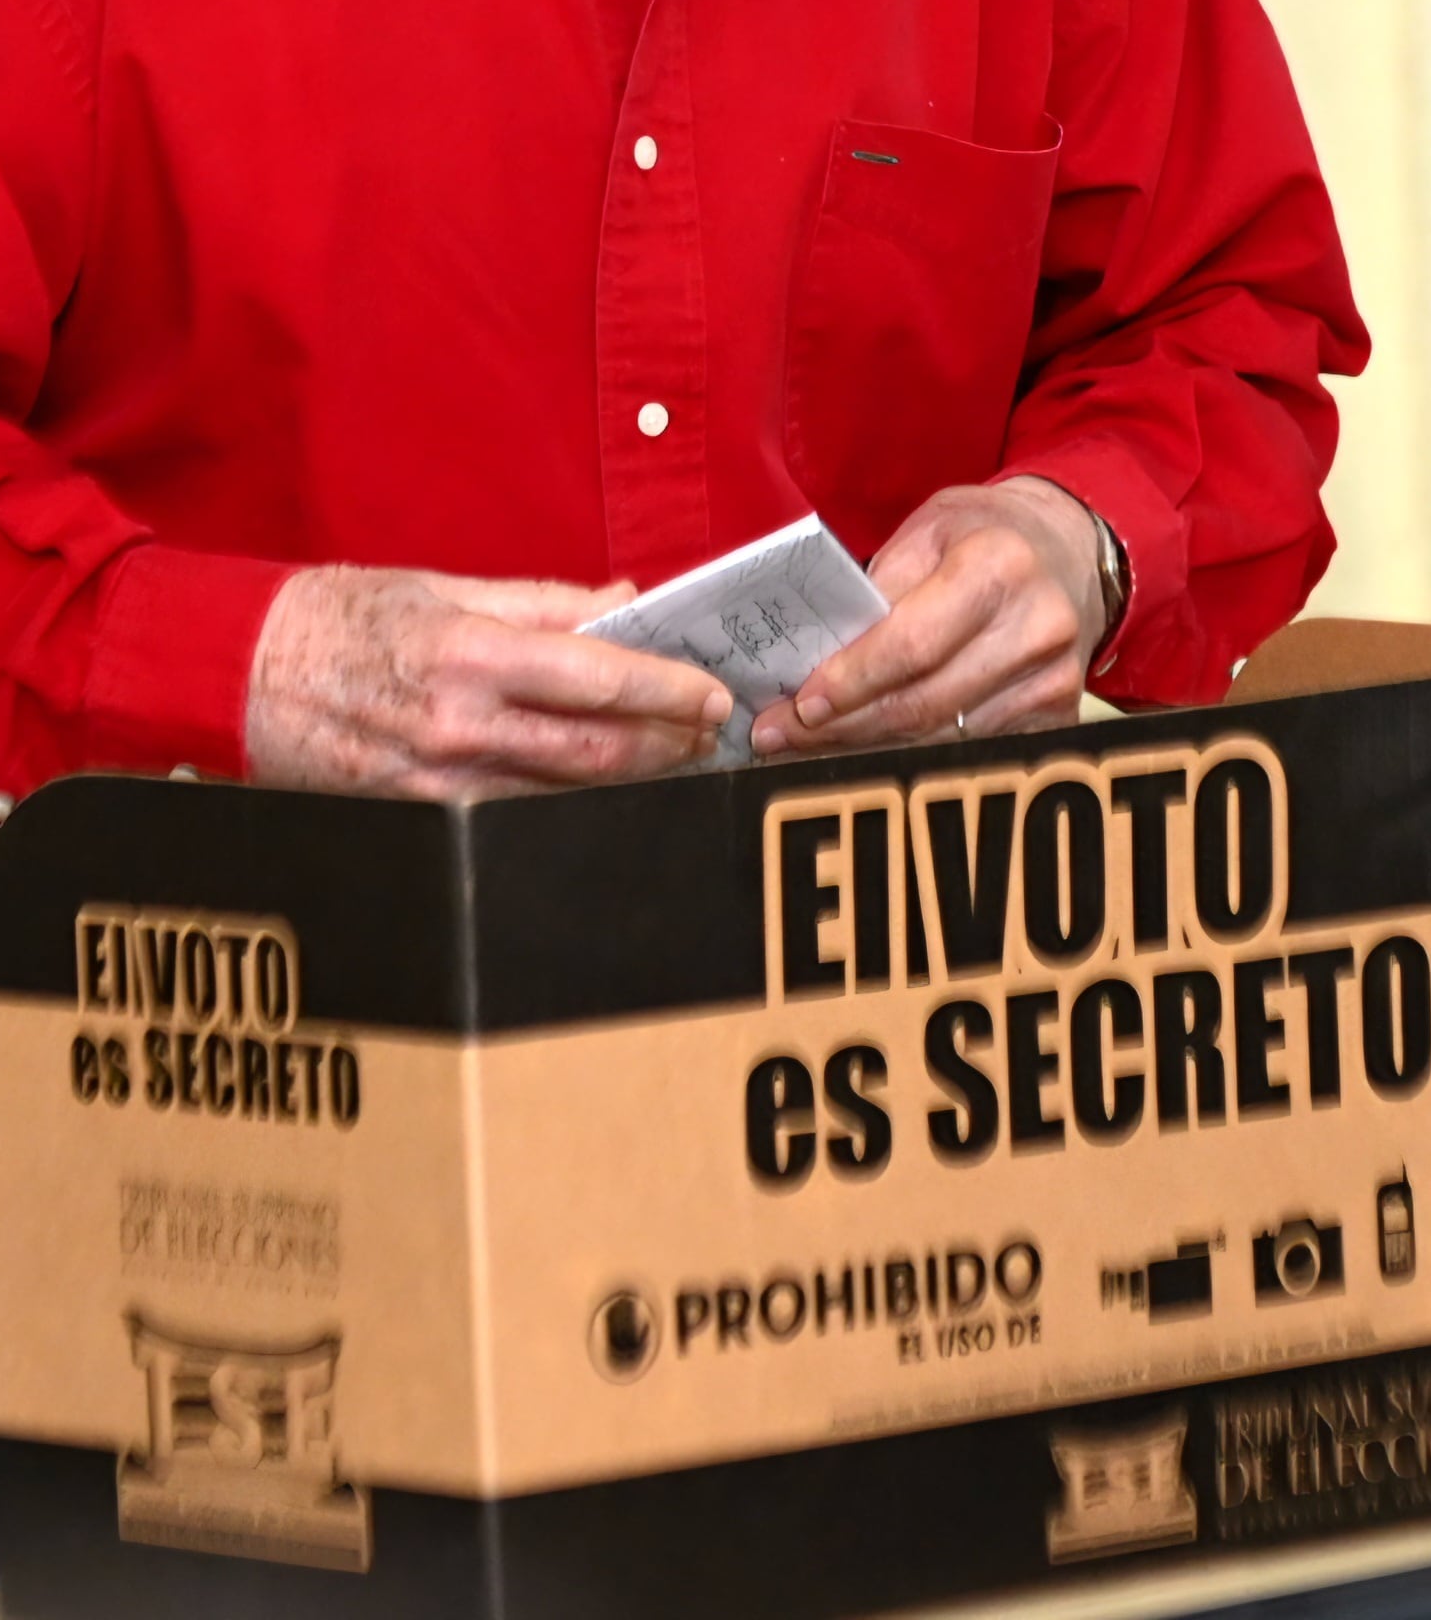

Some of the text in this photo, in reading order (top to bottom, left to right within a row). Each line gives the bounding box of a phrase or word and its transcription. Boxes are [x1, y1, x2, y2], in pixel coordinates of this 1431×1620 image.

[926, 757, 1275, 977] VOTO
[138, 925, 290, 1026] VOTO
[71, 1027, 360, 1133] es SECRETO
[745, 1043, 893, 1188] es
[675, 1240, 1043, 1360] PROHIBIDO
[937, 1321, 996, 1359] USO
[1006, 1311, 1042, 1349] DE
